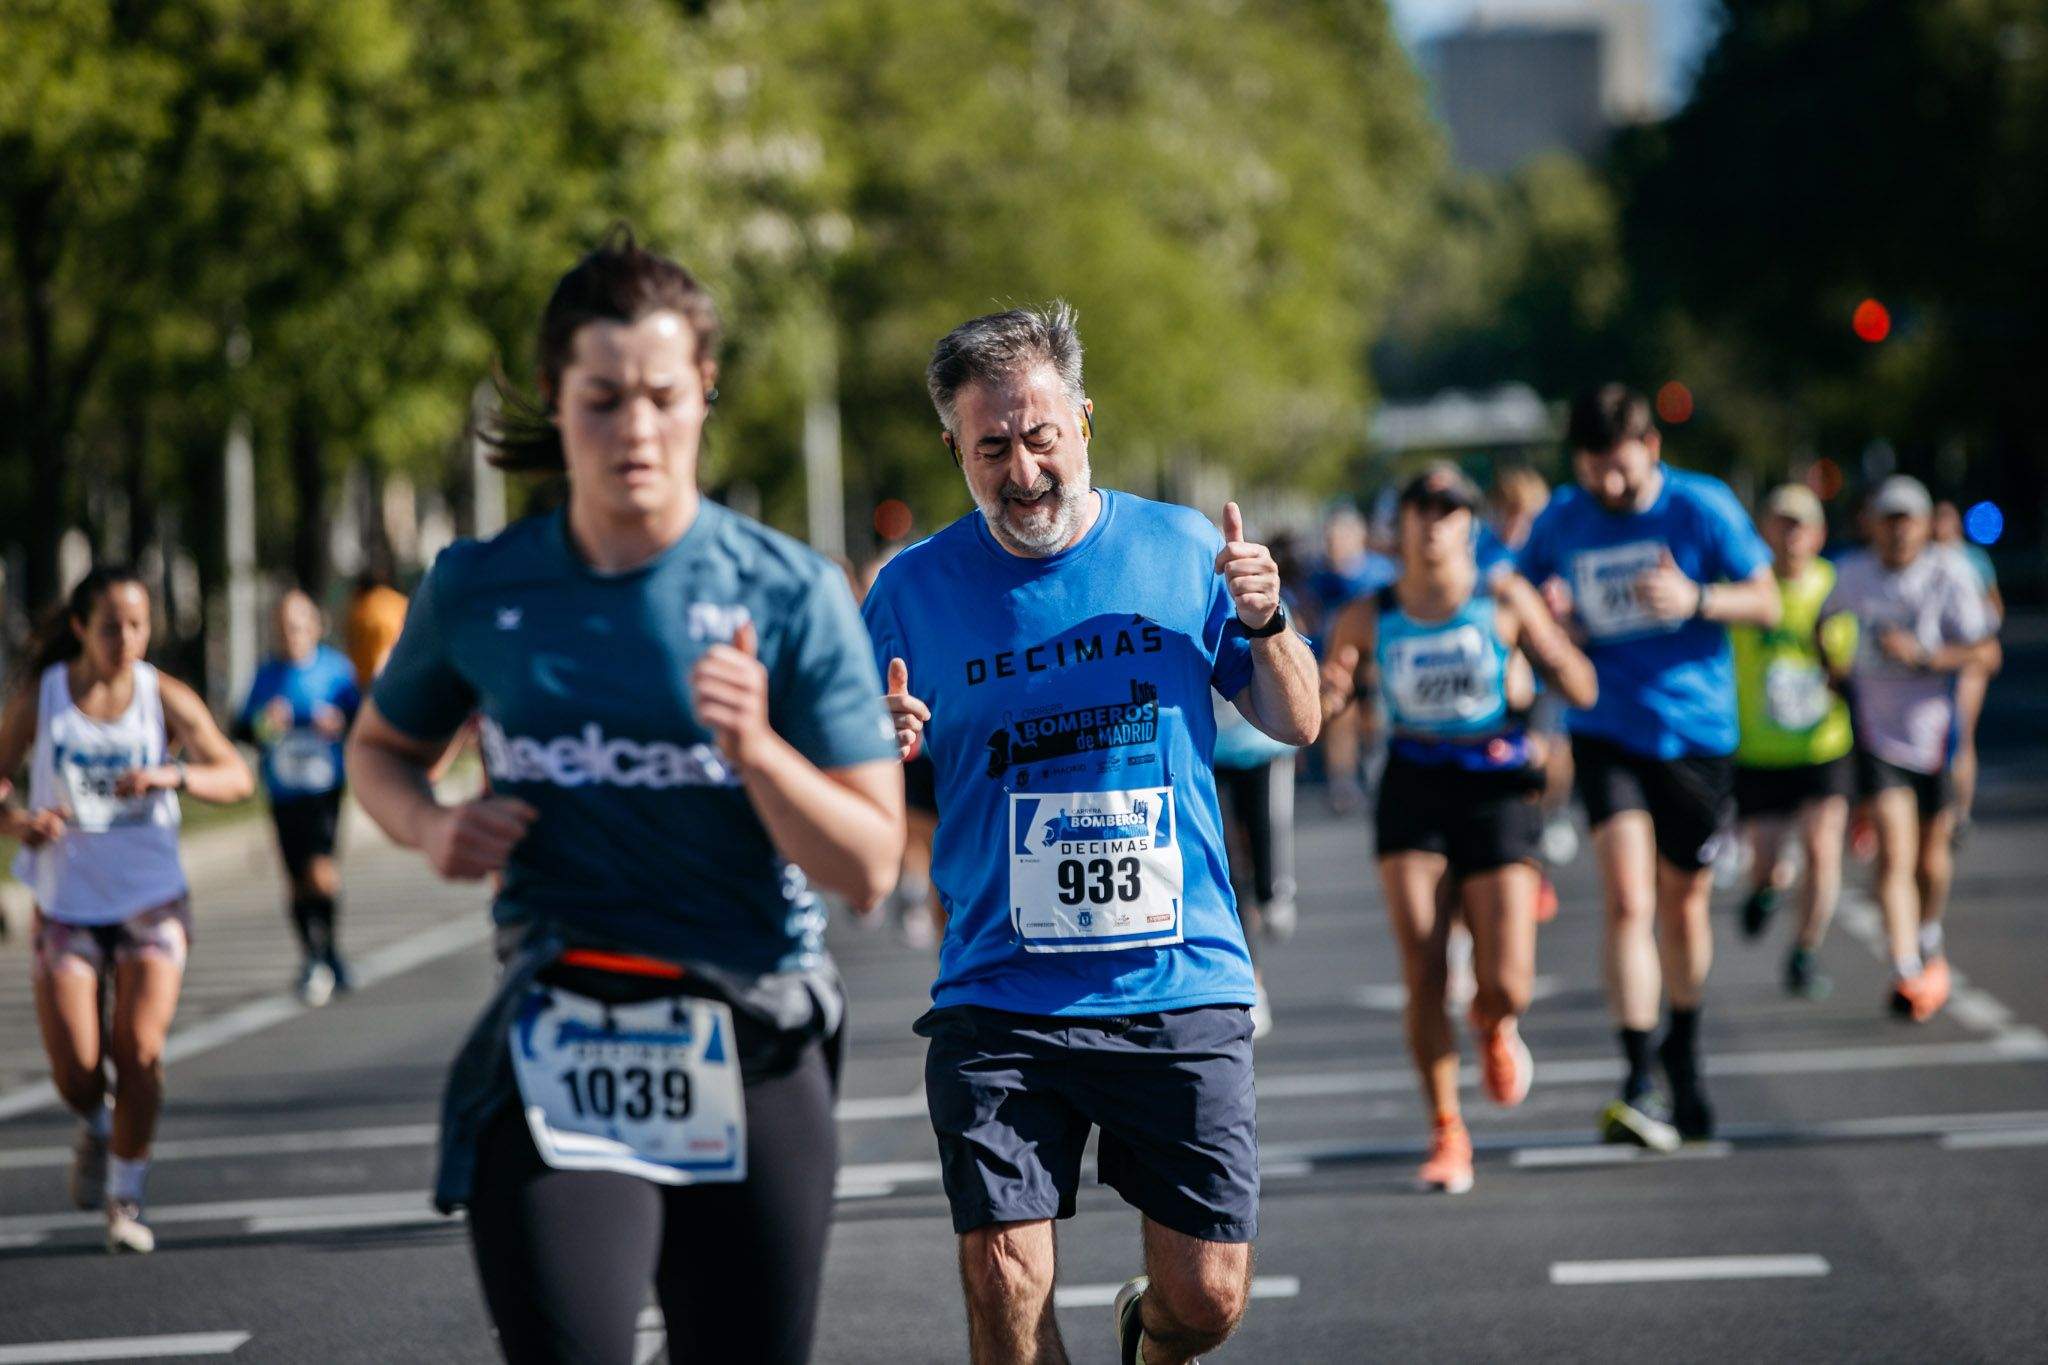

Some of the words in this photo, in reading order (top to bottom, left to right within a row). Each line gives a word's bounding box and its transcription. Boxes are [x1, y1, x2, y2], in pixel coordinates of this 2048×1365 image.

[966, 626, 1164, 686] DECIMAS
[1024, 703, 1154, 739] BOMBEROS
[1077, 732, 1095, 750] de
[1099, 721, 1155, 747] MADRID
[1071, 813, 1145, 828] BOMBEROS
[1061, 839, 1148, 855] DECIMAS
[1057, 856, 1141, 906] 933
[560, 1066, 693, 1122] 1039
